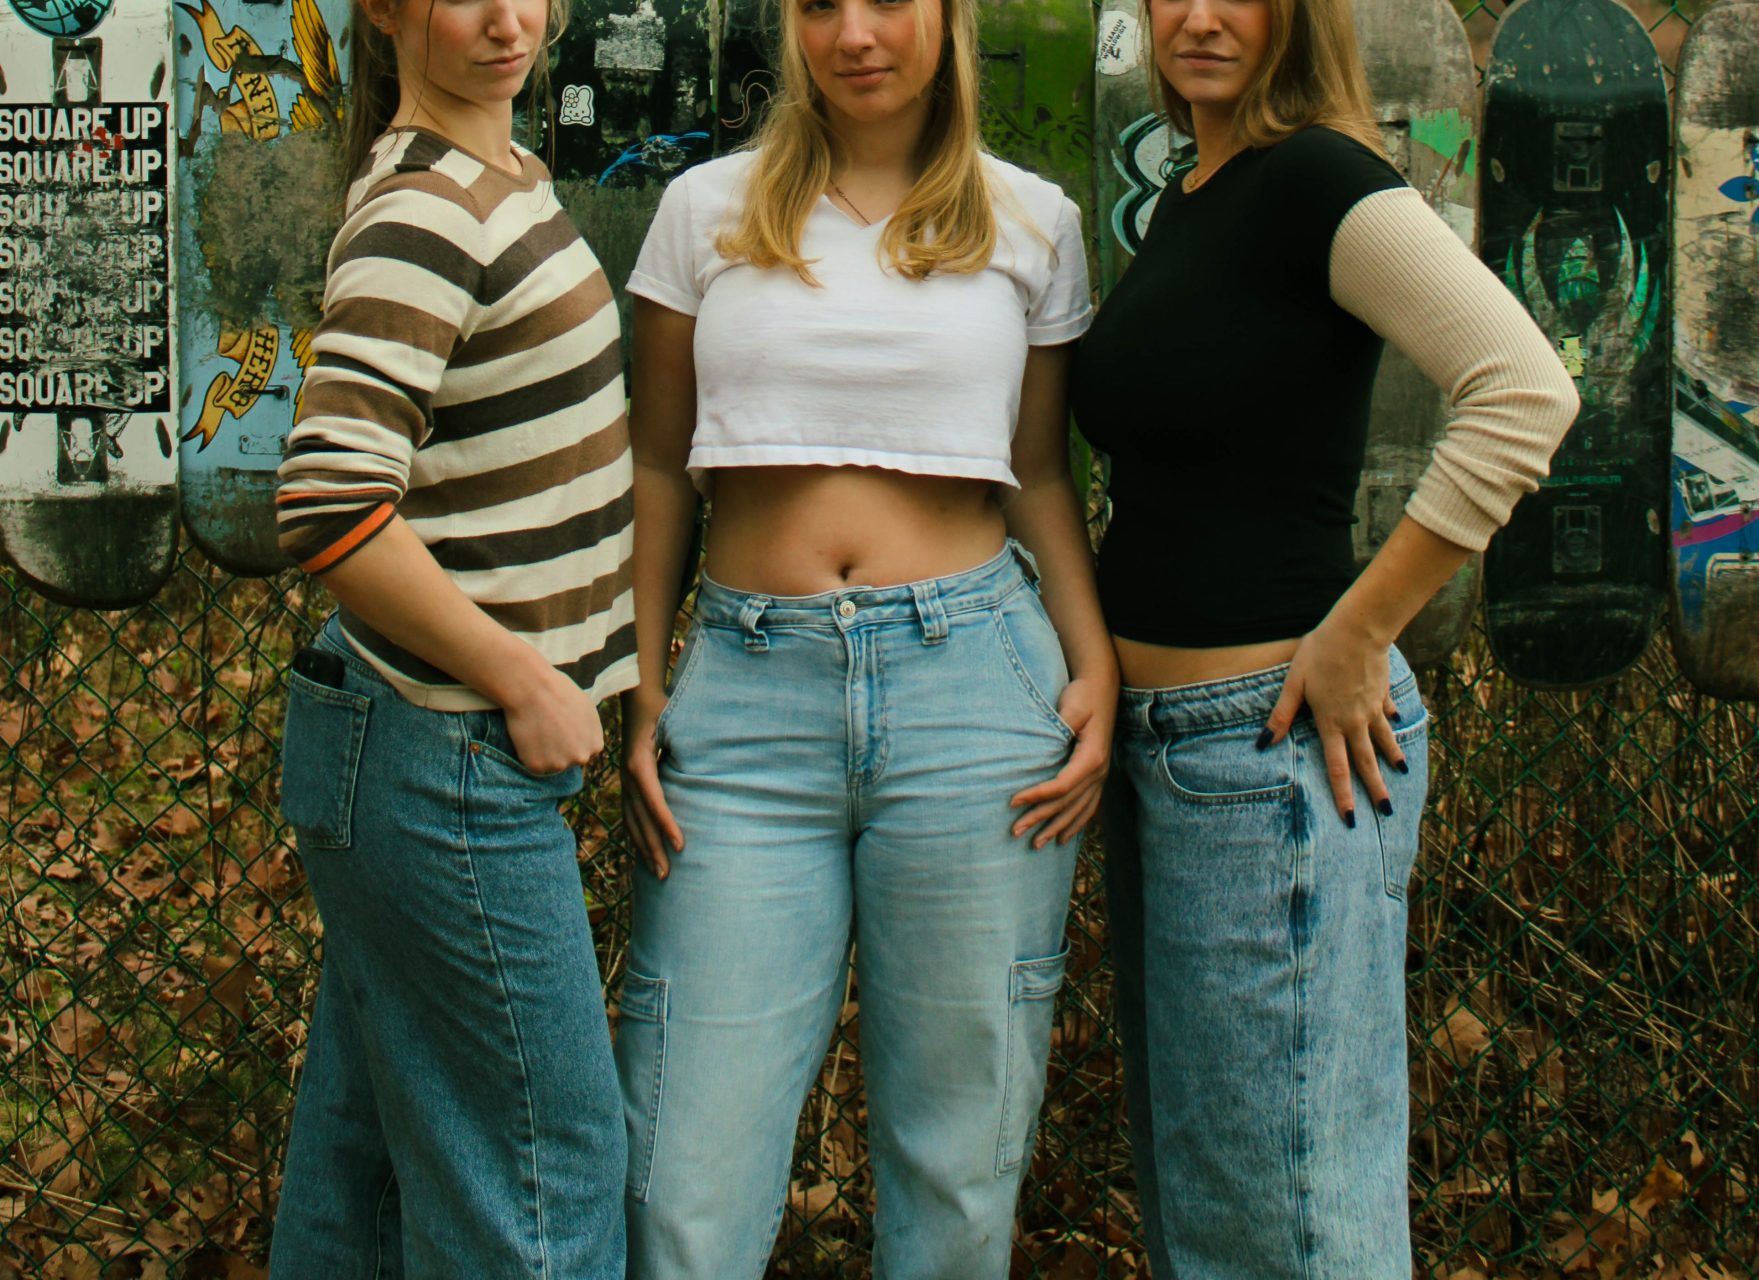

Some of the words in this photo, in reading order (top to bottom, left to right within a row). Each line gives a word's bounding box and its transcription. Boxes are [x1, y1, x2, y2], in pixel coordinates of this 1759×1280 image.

[0, 106, 113, 144] SQUARE
[120, 106, 162, 141] UP
[0, 149, 113, 187] SQUARE
[120, 149, 162, 183] UP
[121, 191, 162, 224] UP
[123, 325, 164, 359] UP
[229, 328, 275, 407] HERO
[0, 371, 109, 408] SQUARE
[124, 371, 165, 407] UP
